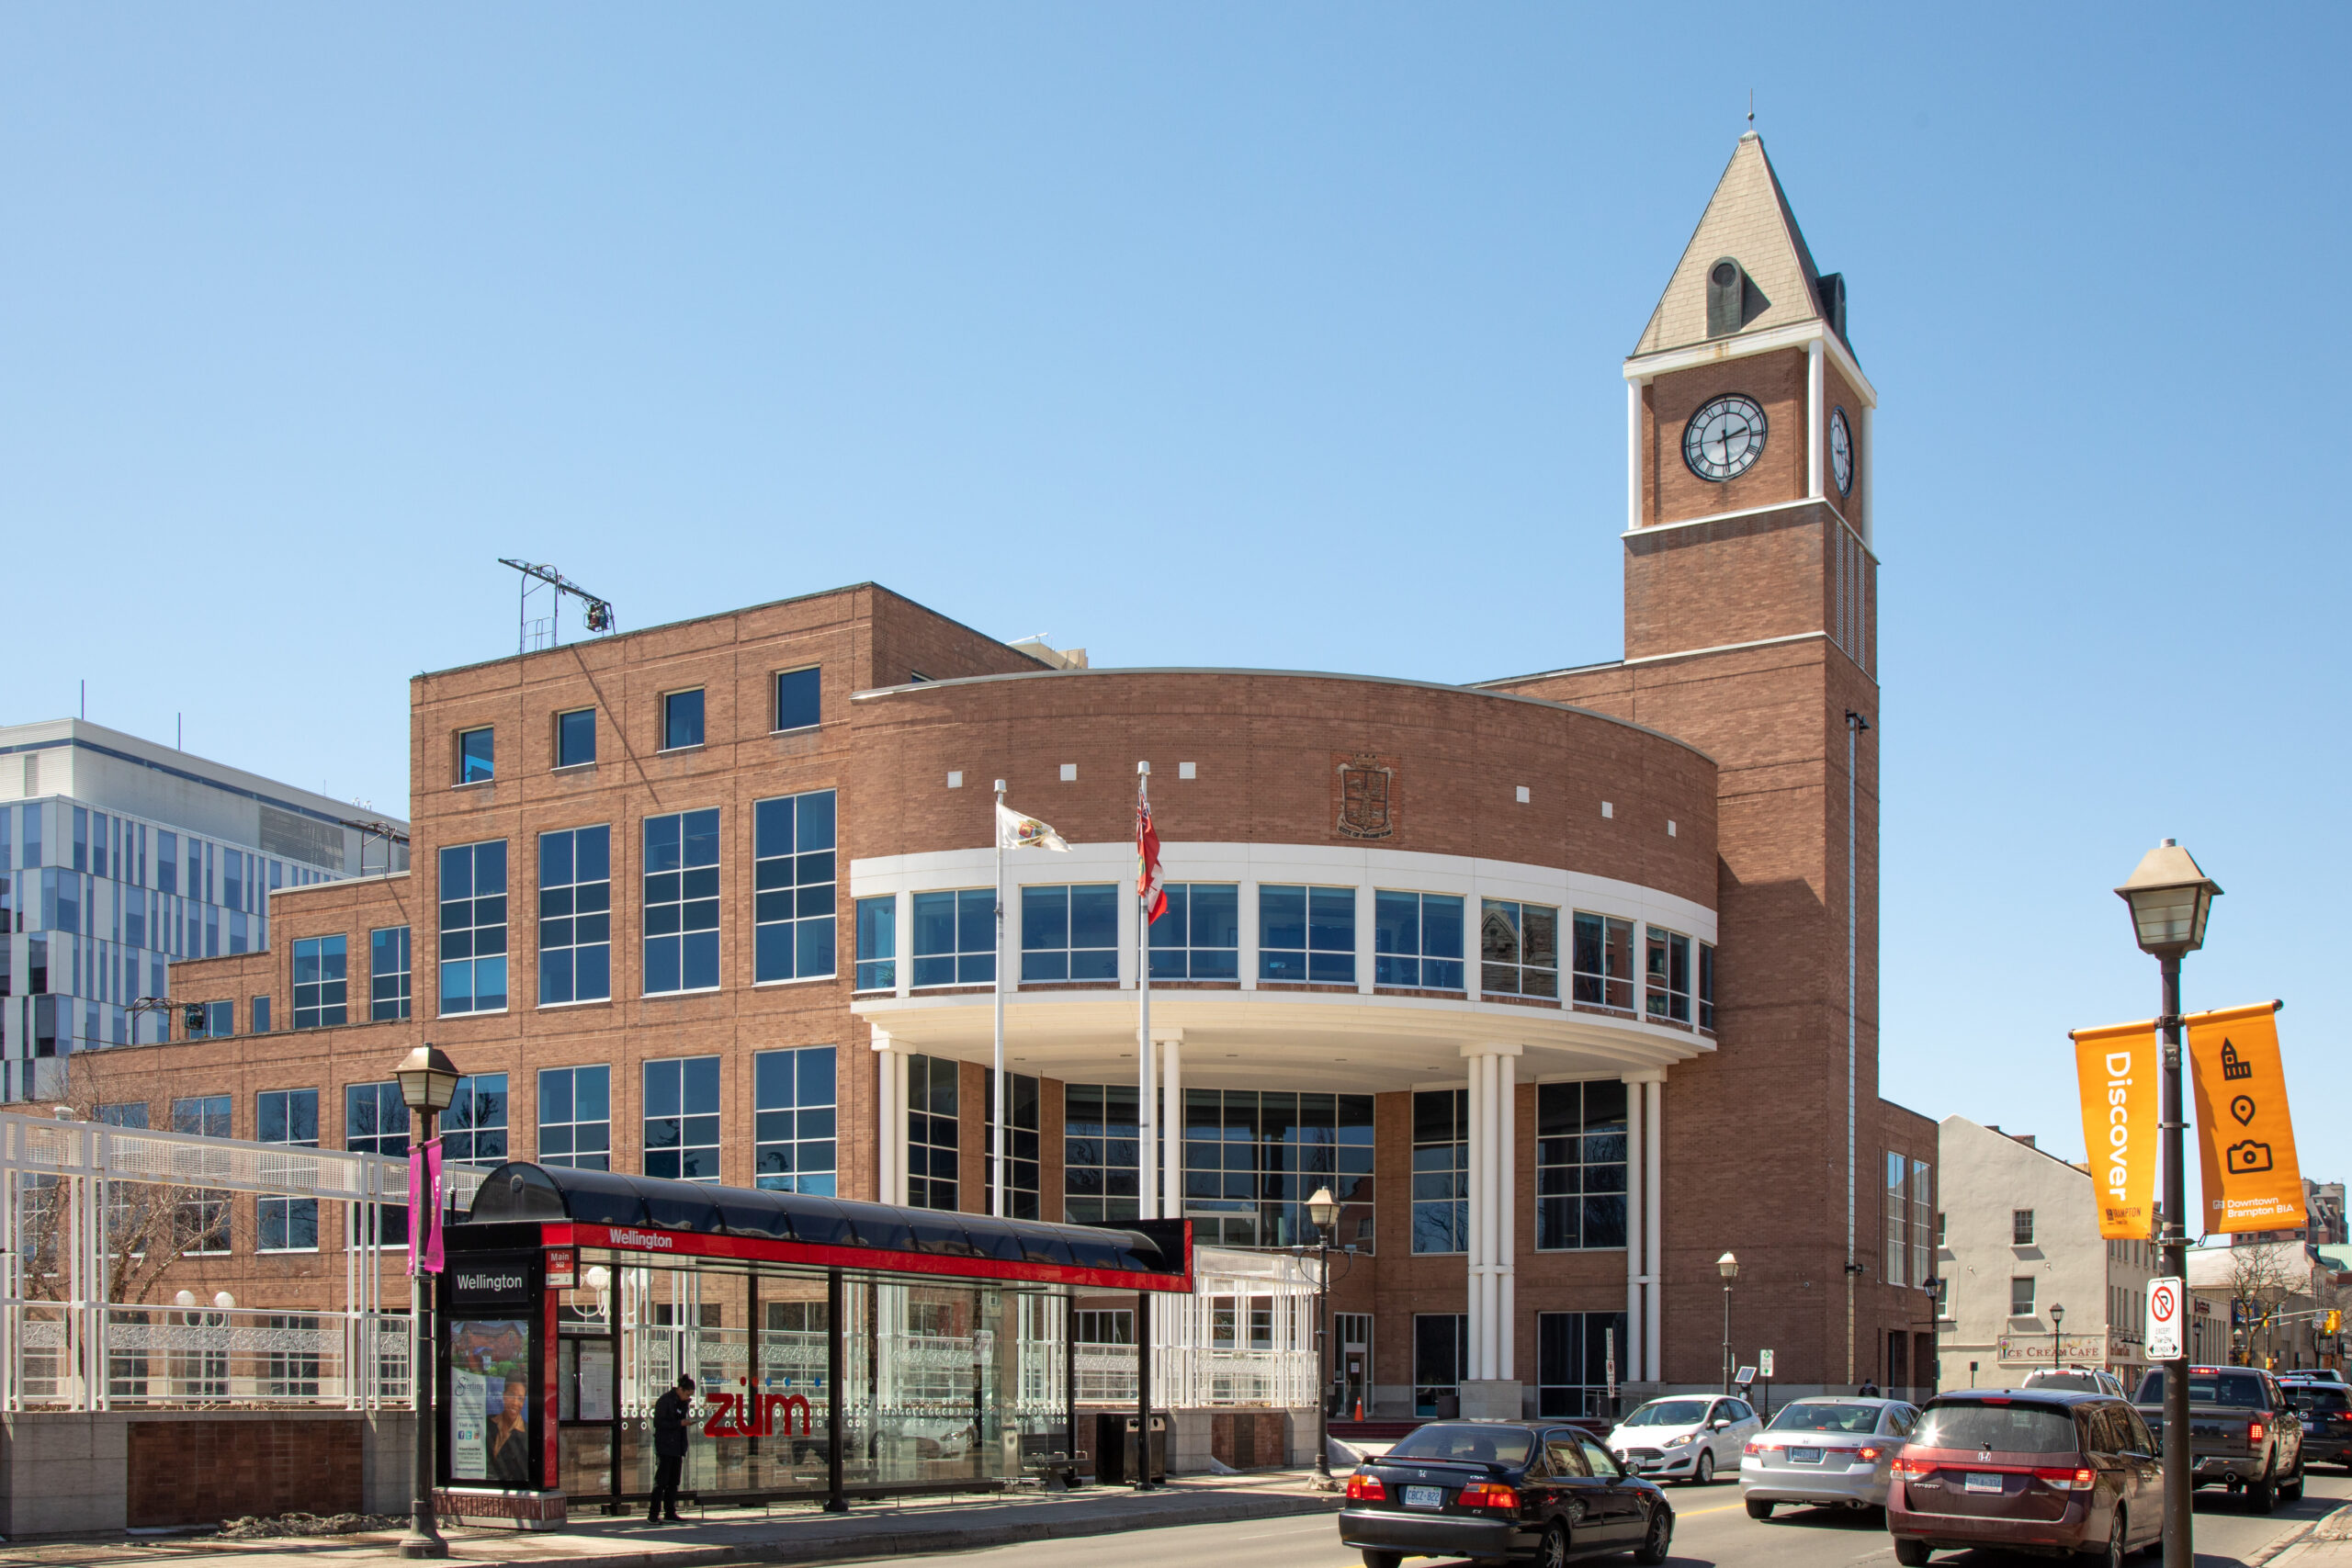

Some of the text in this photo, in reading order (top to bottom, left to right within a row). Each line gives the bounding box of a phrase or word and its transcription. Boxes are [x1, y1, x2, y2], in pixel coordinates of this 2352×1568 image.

[2106, 1051, 2132, 1201] Discover
[2227, 1198, 2278, 1209] Downtown
[2227, 1203, 2294, 1218] Brampton BIA
[609, 1228, 673, 1249] Wellington
[550, 1252, 570, 1261] Main
[457, 1274, 522, 1292] Wellington
[2027, 1347, 2067, 1357] CREAM
[2069, 1347, 2098, 1357] CAFE
[455, 1376, 484, 1396] Sterling
